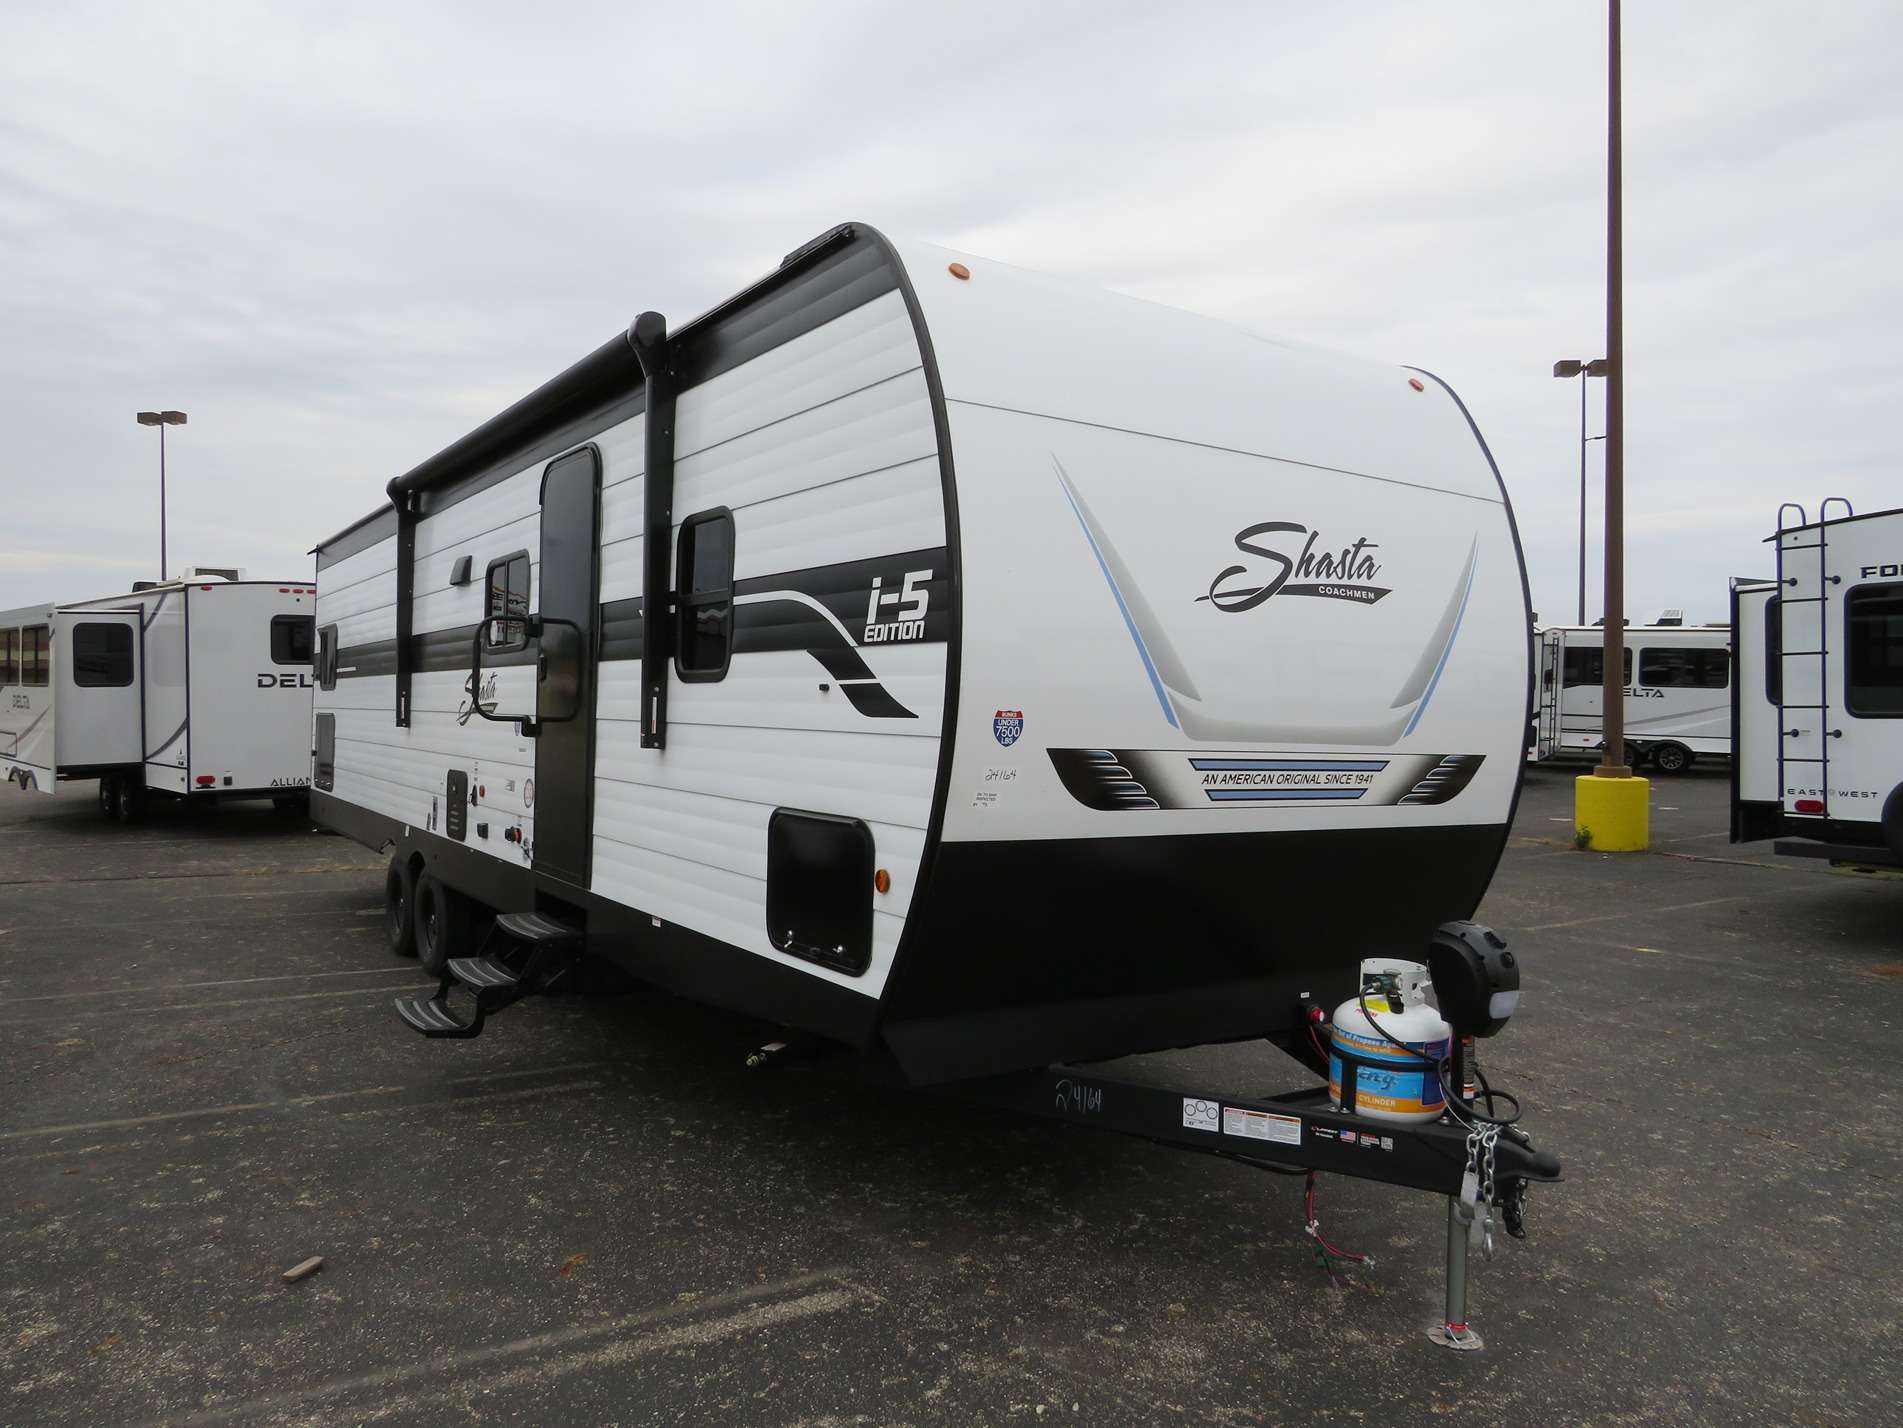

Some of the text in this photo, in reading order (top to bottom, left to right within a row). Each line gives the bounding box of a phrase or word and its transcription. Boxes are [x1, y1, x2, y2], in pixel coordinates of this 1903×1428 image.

[1209, 521, 1382, 613] Shasta
[1860, 564, 1903, 579] FO
[866, 569, 933, 625] i-5
[1318, 585, 1375, 600] COACHMEN
[863, 620, 925, 643] EDITION
[257, 673, 313, 688] DEL
[1623, 688, 1664, 698] ELTA
[997, 719, 1020, 727] UNDER
[996, 726, 1021, 738] 7500
[270, 777, 312, 787] ALLIAN
[1201, 774, 1374, 785] AN AMERICAN ORIGINAL SINCE 1941
[1787, 788, 1879, 798] EAST WEST
[1358, 1094, 1397, 1108] CYLINDER
